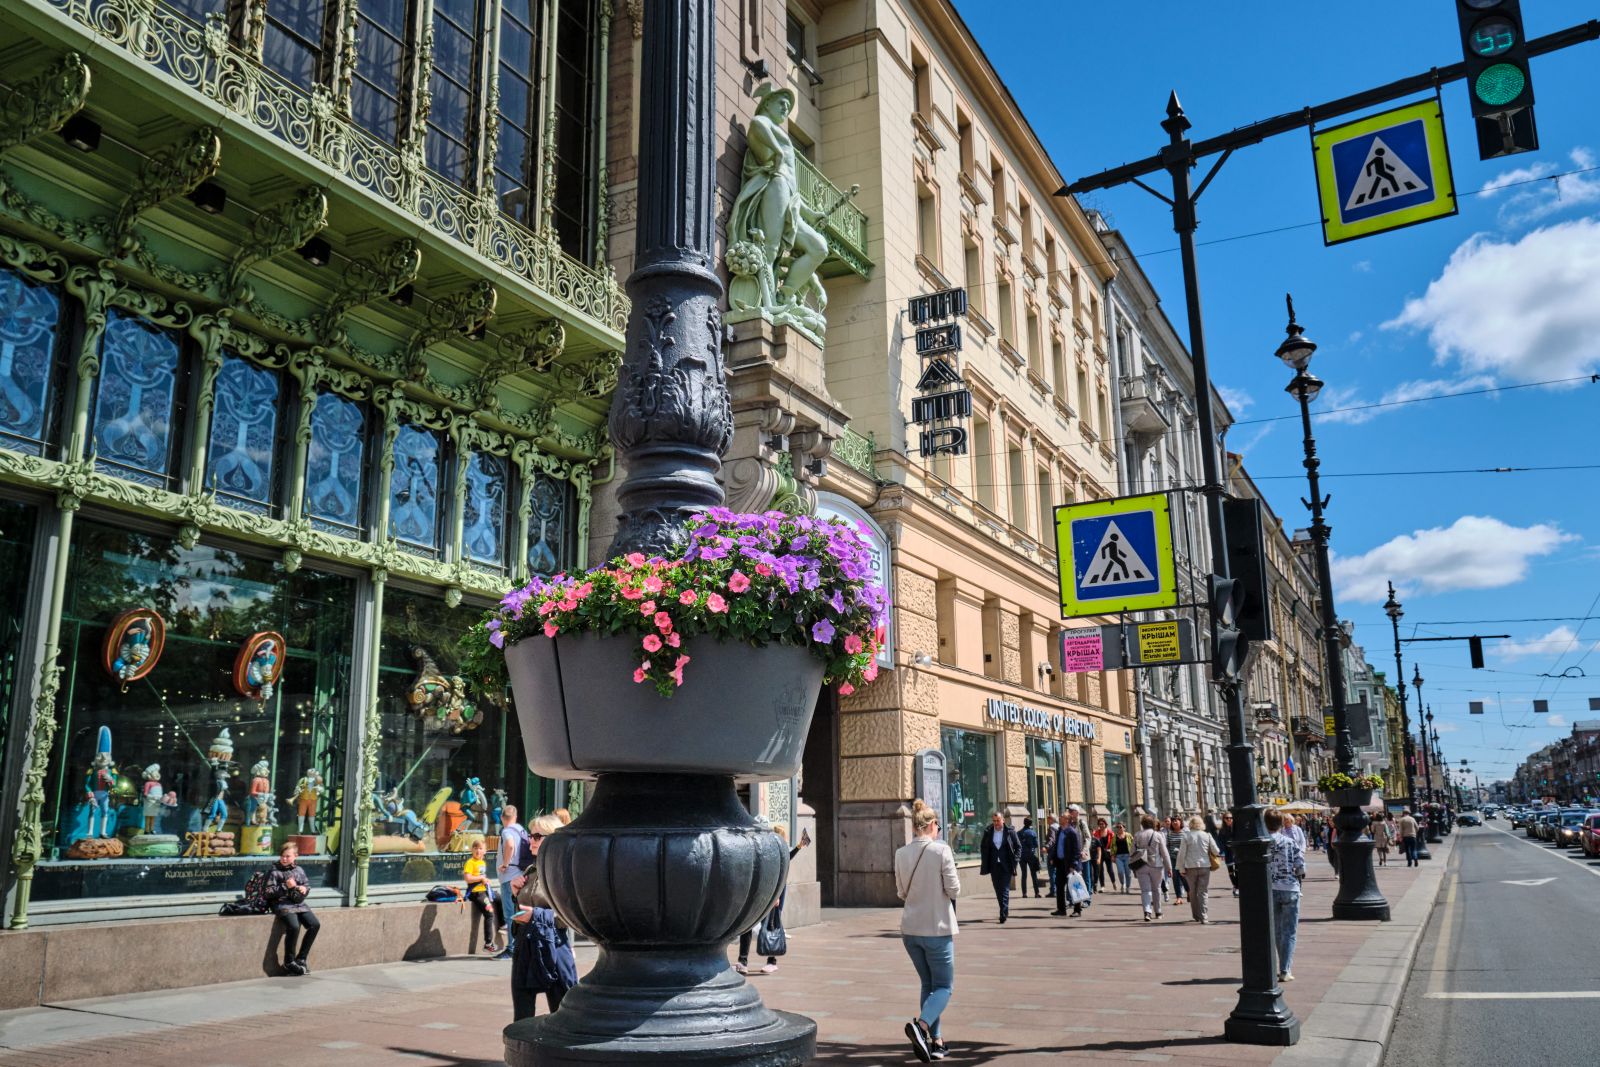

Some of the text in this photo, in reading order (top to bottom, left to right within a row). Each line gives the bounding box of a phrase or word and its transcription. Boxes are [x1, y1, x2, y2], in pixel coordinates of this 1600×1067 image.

[1141, 632, 1175, 640] КРЫШАМ
[1067, 649, 1100, 657] КРЫШАХ
[988, 697, 1096, 740] UNITED COLORS OF BENETTON
